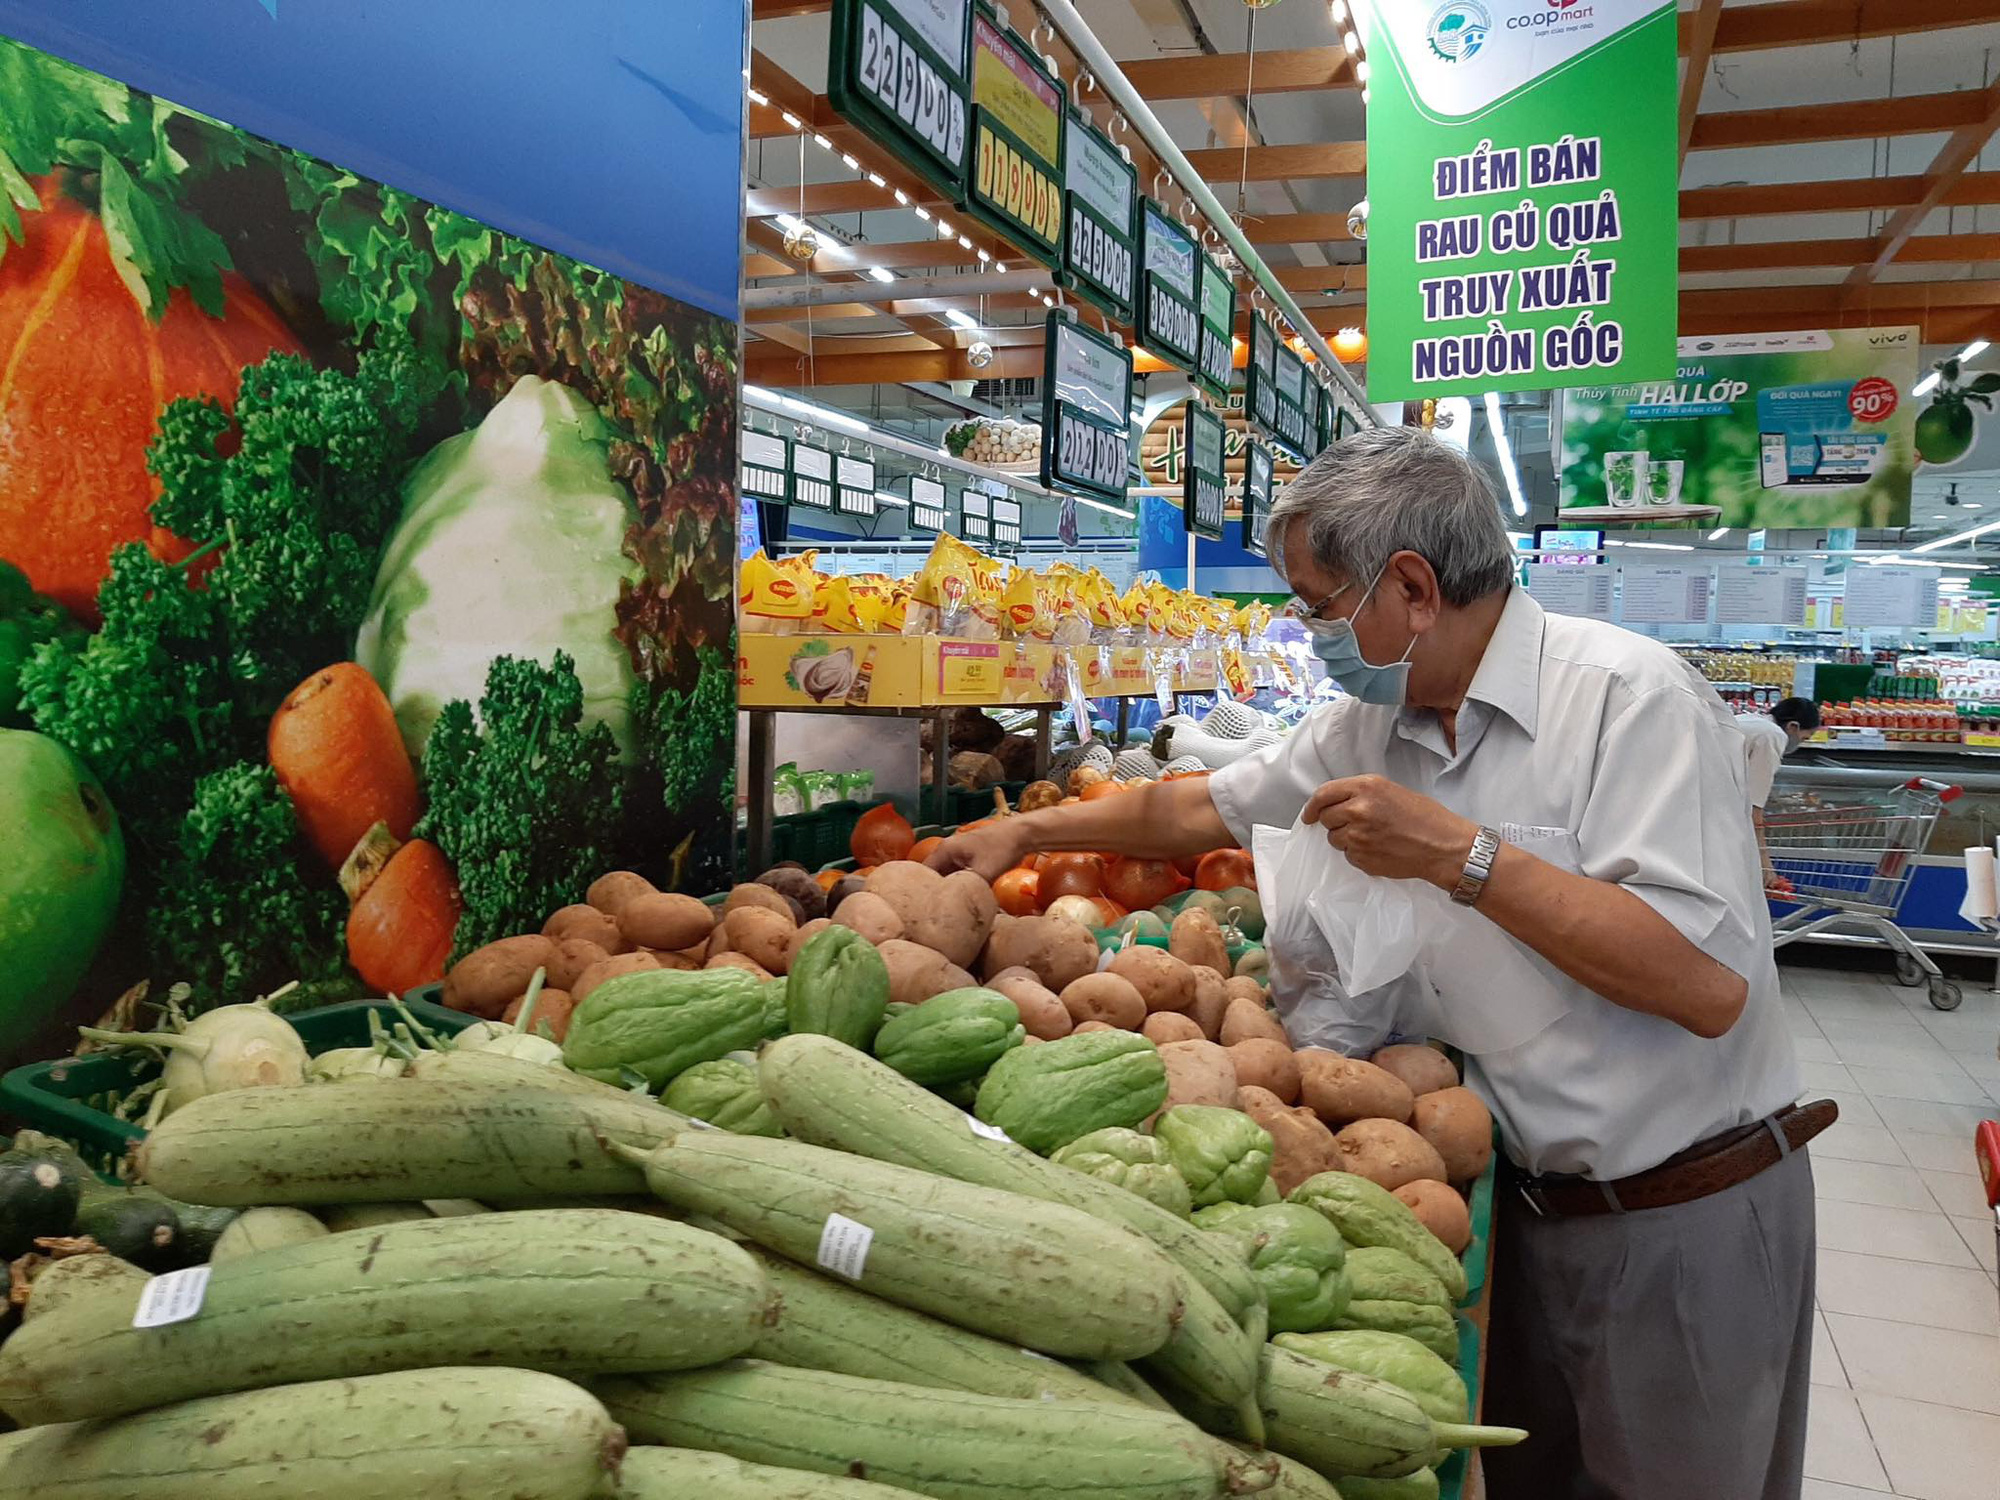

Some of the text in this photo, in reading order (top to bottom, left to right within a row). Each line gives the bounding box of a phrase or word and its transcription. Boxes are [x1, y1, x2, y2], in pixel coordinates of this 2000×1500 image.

[1436, 138, 1597, 197] ĐIỂM BÁN
[1418, 192, 1618, 260] RAU CỦ QUẢ
[1422, 251, 1613, 319] TRUY XUẤT
[1415, 313, 1619, 380] NGUỒN GỐC
[1869, 333, 1907, 346] vivo
[1638, 378, 1749, 406] HAI LỚP
[1852, 393, 1895, 415] 90%
